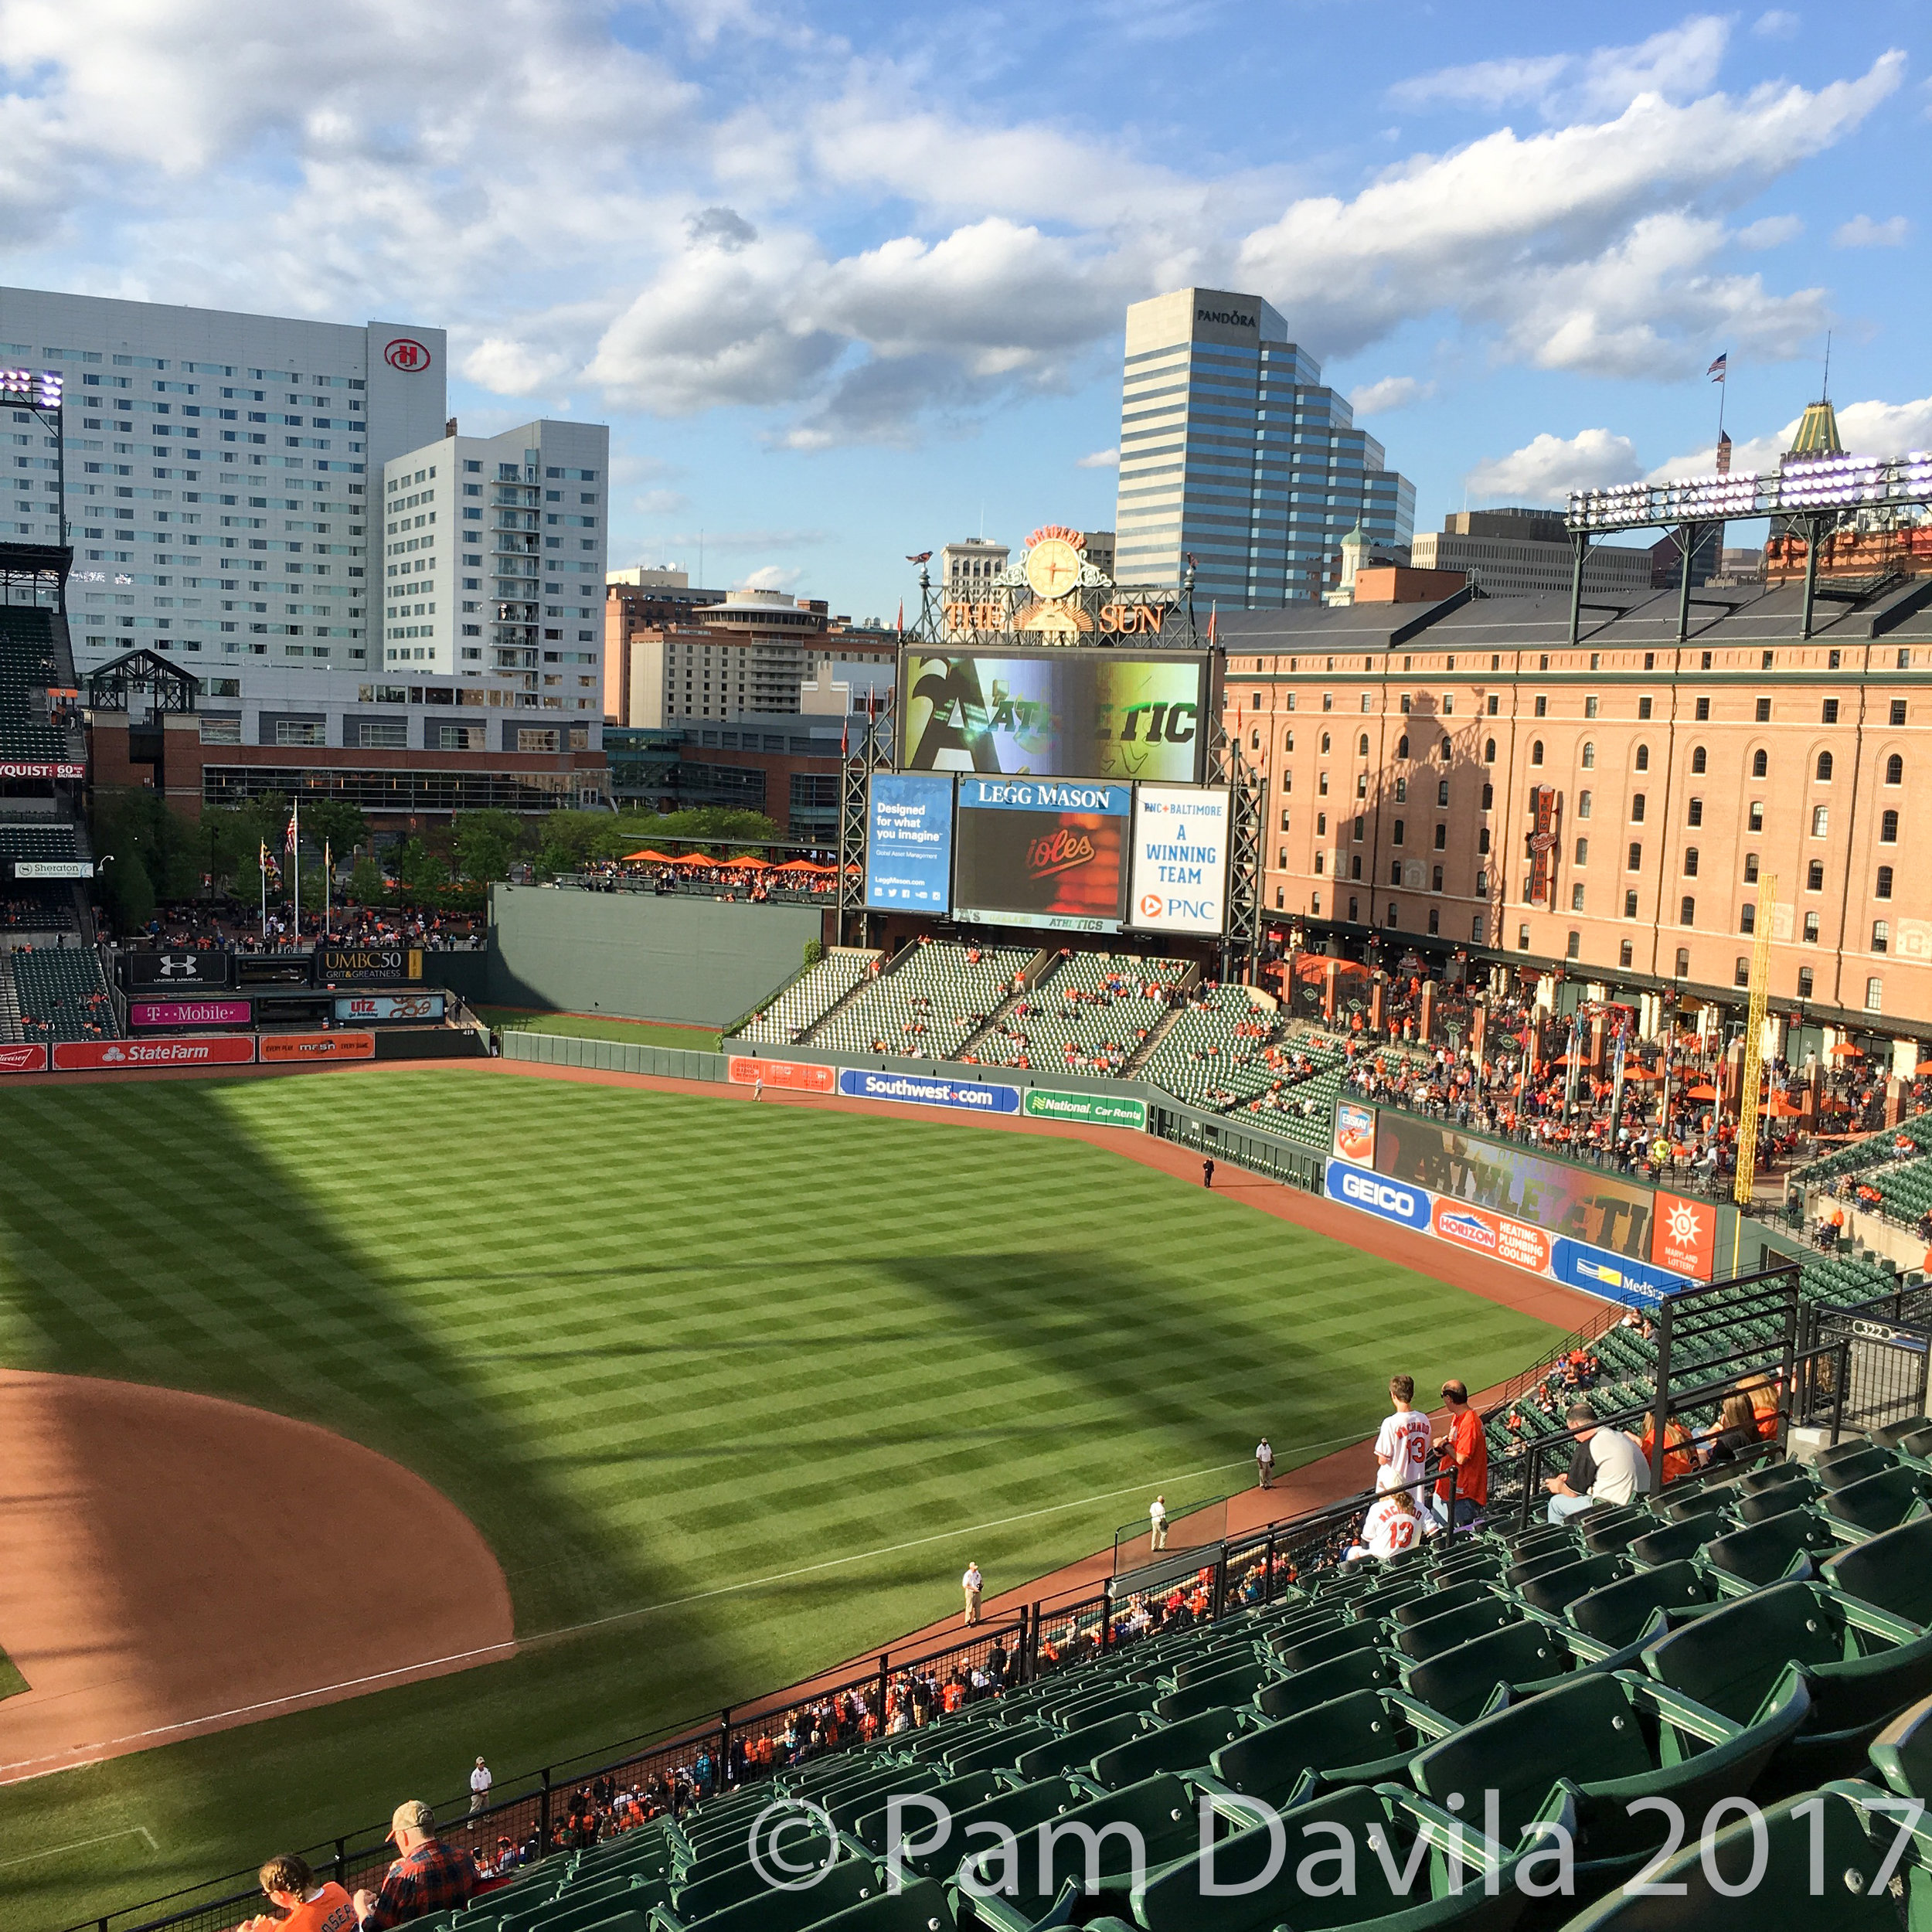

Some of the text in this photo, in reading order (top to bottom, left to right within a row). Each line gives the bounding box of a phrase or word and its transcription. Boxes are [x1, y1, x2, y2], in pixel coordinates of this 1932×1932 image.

[944, 602, 1165, 634] THE SUN
[57, 765, 73, 774] 60
[978, 782, 1111, 809] LEGG MASON
[877, 803, 925, 815] Designed
[877, 816, 921, 828] for what
[877, 829, 940, 842] you imagine
[1176, 824, 1186, 841] A
[1146, 844, 1216, 864] WINNING
[875, 876, 925, 886] LeggMason.com
[1158, 866, 1202, 885] TEAM
[1167, 898, 1215, 920] PNC
[1045, 1098, 1141, 1121] National Car Rental
[1342, 1173, 1414, 1217] GEICO
[1440, 1217, 1495, 1247] HORIZON
[1499, 1221, 1538, 1242] HEATING
[1498, 1233, 1544, 1257] PLUMBING
[1498, 1245, 1537, 1267] COOLING
[1665, 1247, 1698, 1264] MARYLAND
[1668, 1257, 1696, 1272] LOTTERY
[1861, 1323, 1883, 1338] 322
[1406, 1437, 1426, 1464] 13
[1389, 1521, 1414, 1549] 13
